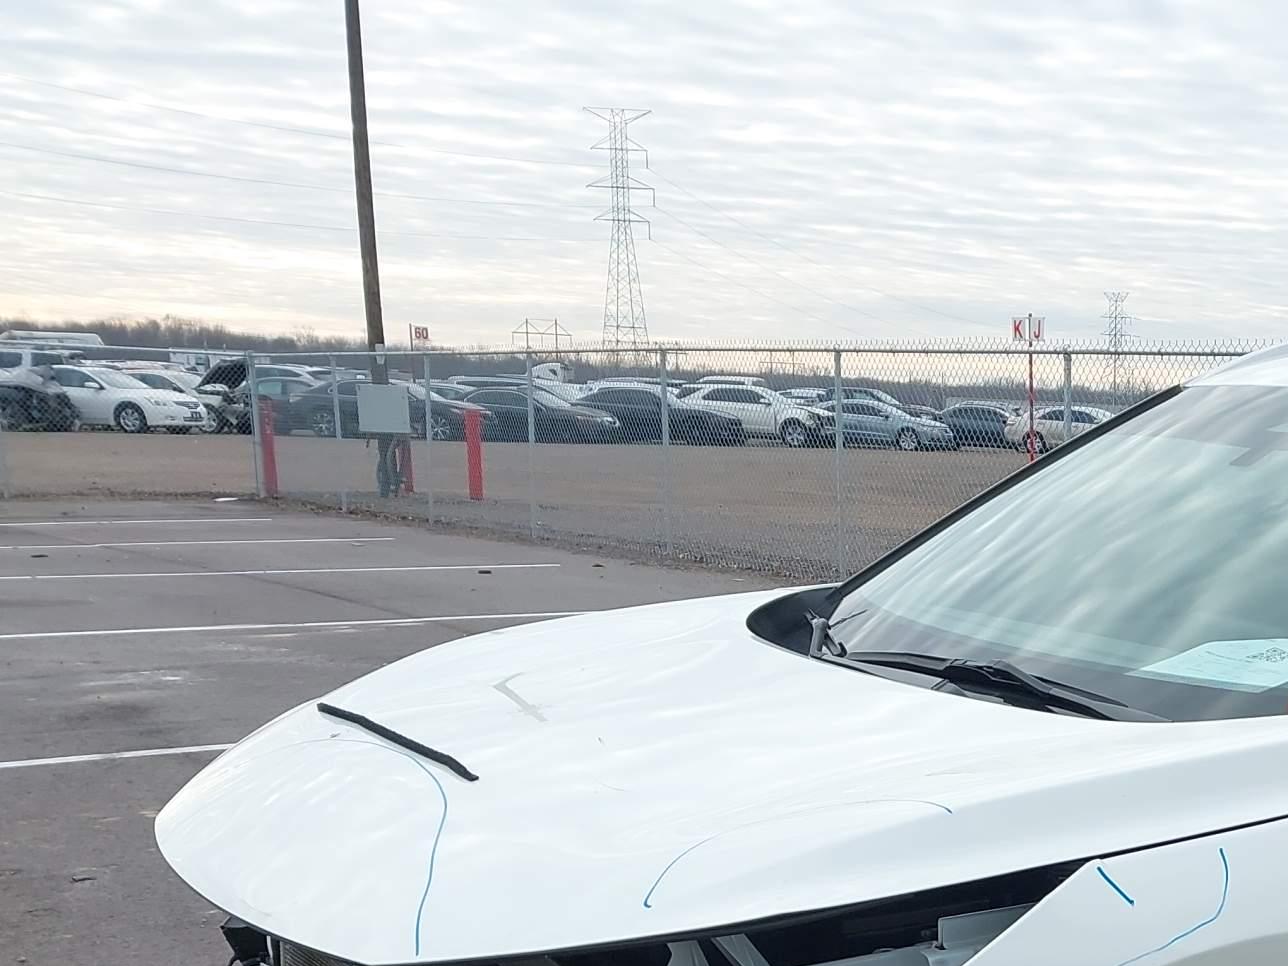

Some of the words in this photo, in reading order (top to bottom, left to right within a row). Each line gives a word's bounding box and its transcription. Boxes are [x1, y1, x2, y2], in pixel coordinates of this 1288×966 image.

[414, 326, 429, 340] 60
[1014, 320, 1023, 339] K
[1034, 320, 1041, 339] J
